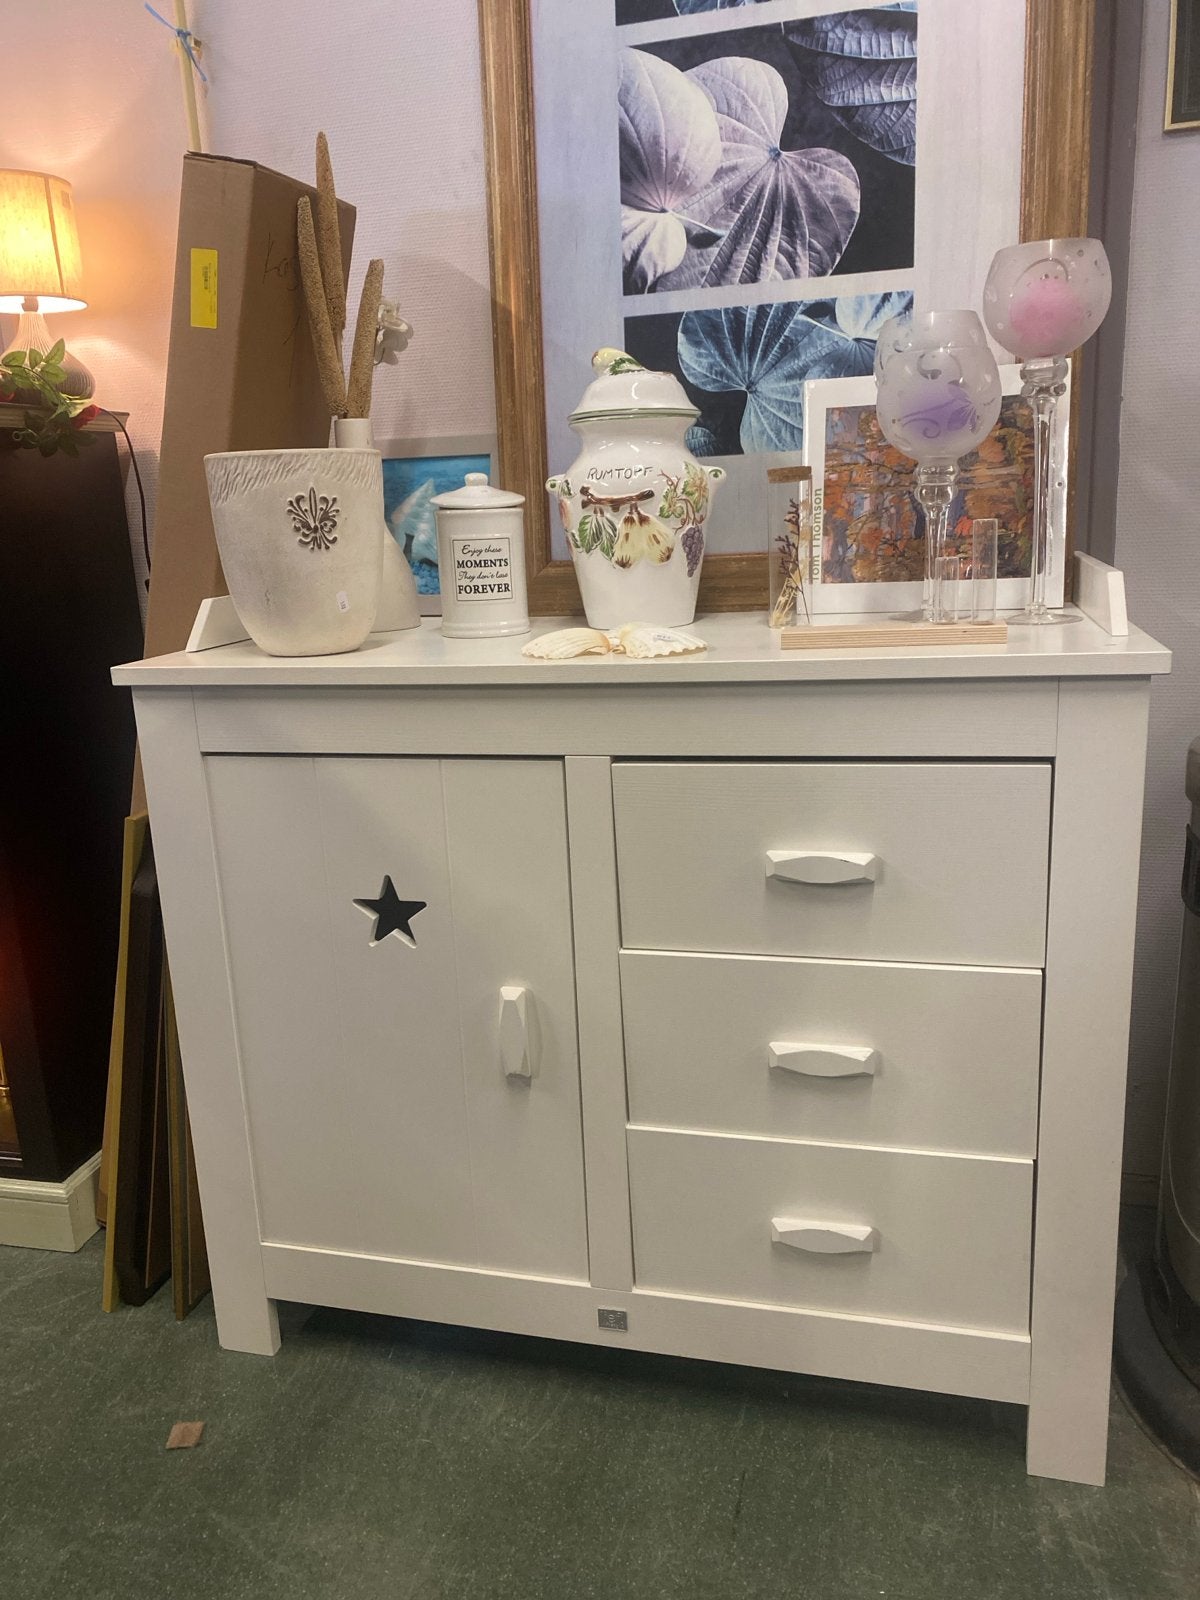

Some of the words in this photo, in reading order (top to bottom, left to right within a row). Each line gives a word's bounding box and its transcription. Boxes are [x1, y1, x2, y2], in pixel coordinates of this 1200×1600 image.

[587, 466, 654, 481] RUMTOPF
[812, 488, 822, 547] Thomson
[461, 544, 483, 557] Enjoy
[484, 545, 502, 553] these
[456, 558, 509, 569] MOMENTS
[457, 570, 476, 582] They
[477, 571, 495, 579] don't
[457, 582, 511, 595] FOREVER
